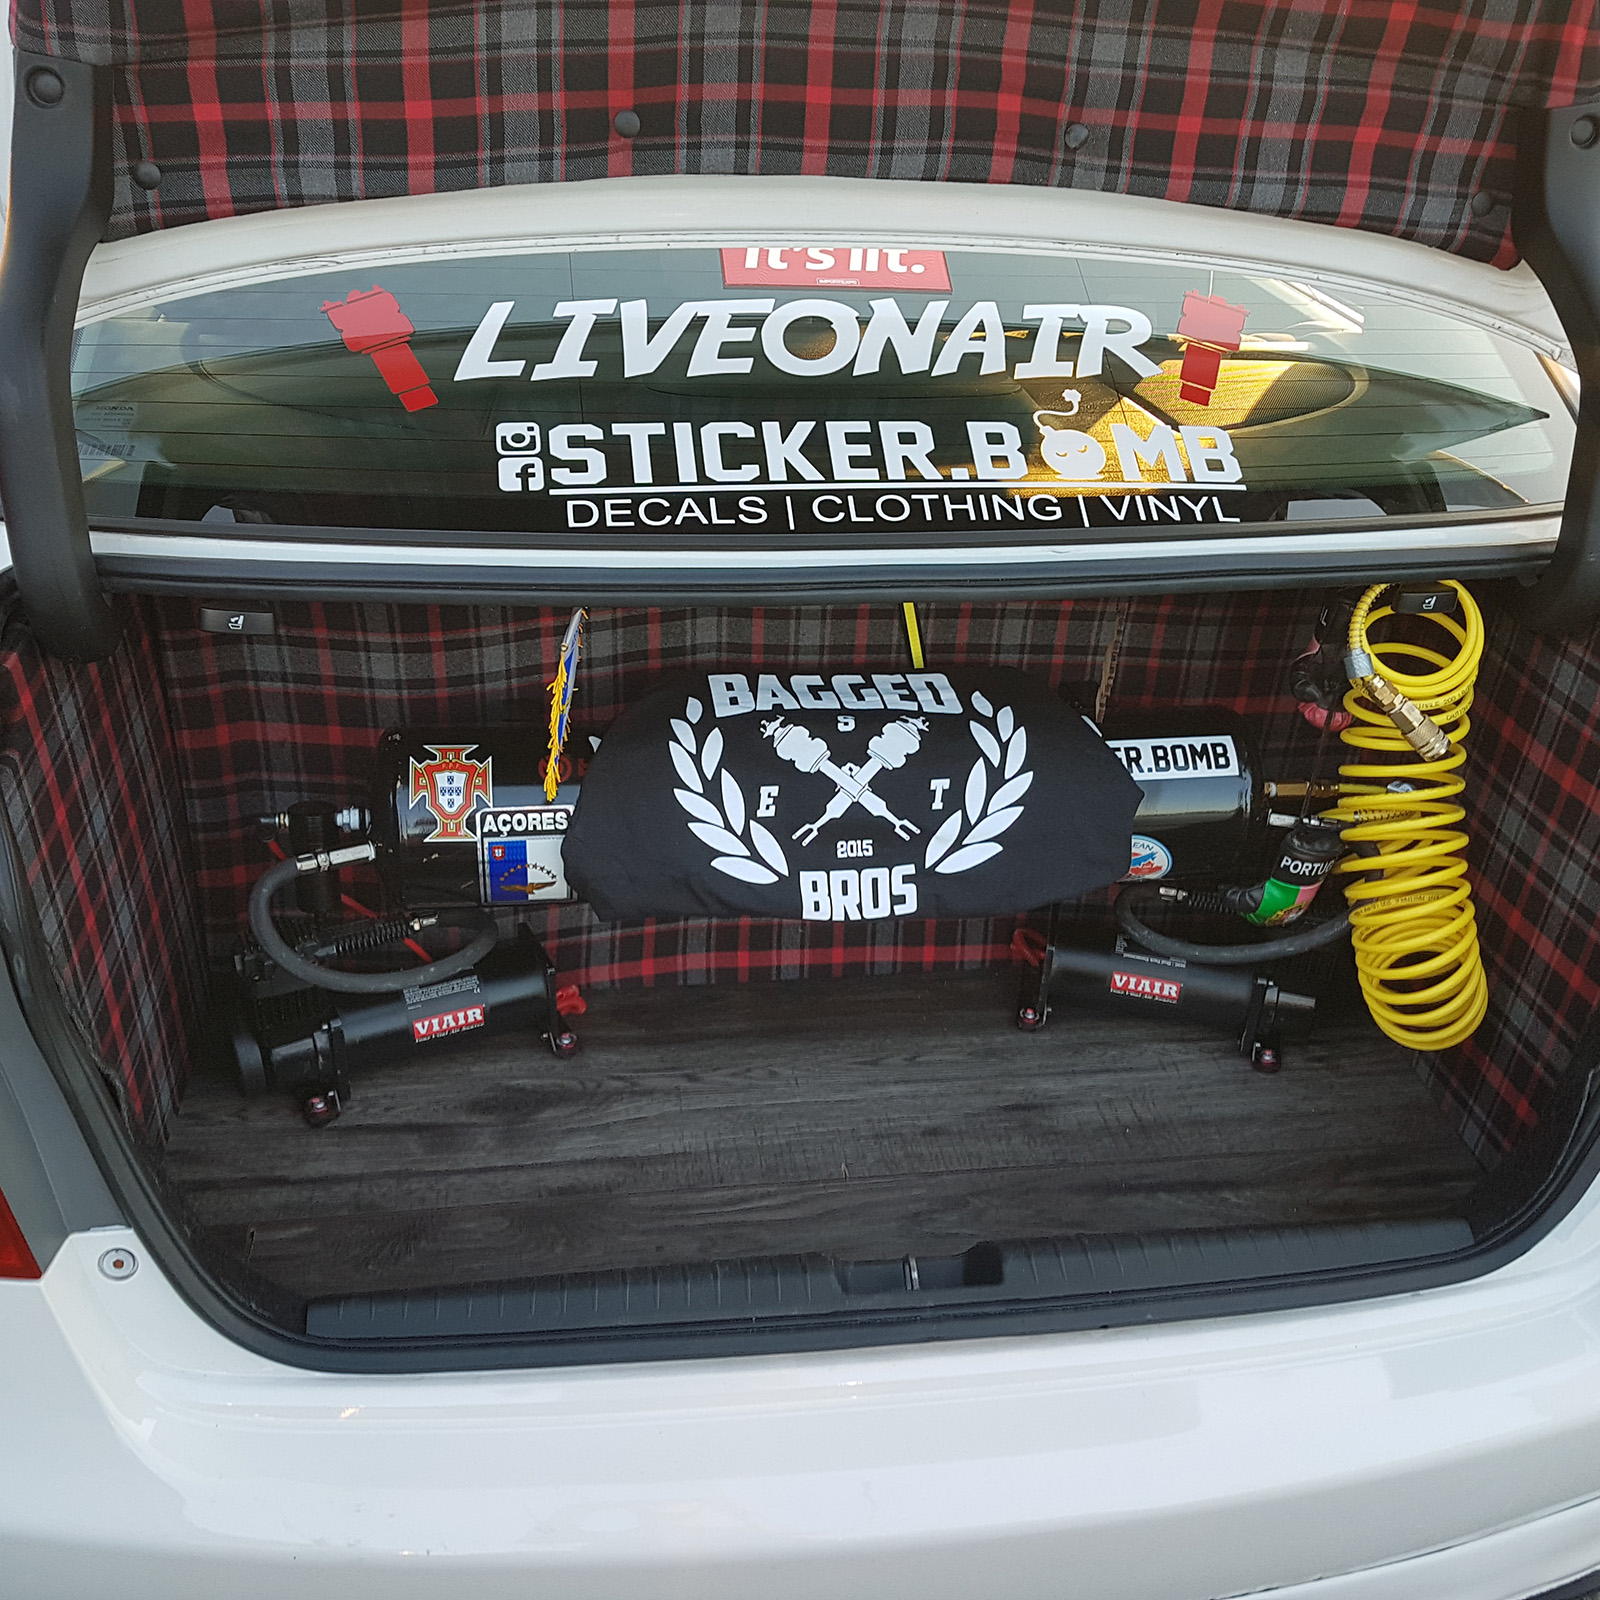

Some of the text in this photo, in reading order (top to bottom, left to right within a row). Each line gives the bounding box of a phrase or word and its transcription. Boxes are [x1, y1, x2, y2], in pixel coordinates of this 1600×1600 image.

[454, 297, 1163, 381] LIVEONAIR
[566, 493, 1241, 529] DECALS CLOTHING VINYL
[707, 672, 964, 718] BAGGED
[756, 785, 780, 817] E
[929, 778, 951, 810] T
[482, 809, 568, 837] AÇORES
[836, 839, 873, 858] 2015
[1133, 842, 1154, 851] EAN
[1279, 856, 1335, 877] PORTUG
[799, 863, 918, 921] BROS
[1113, 974, 1178, 998] VIAIR
[415, 1007, 483, 1035] VIAIR
